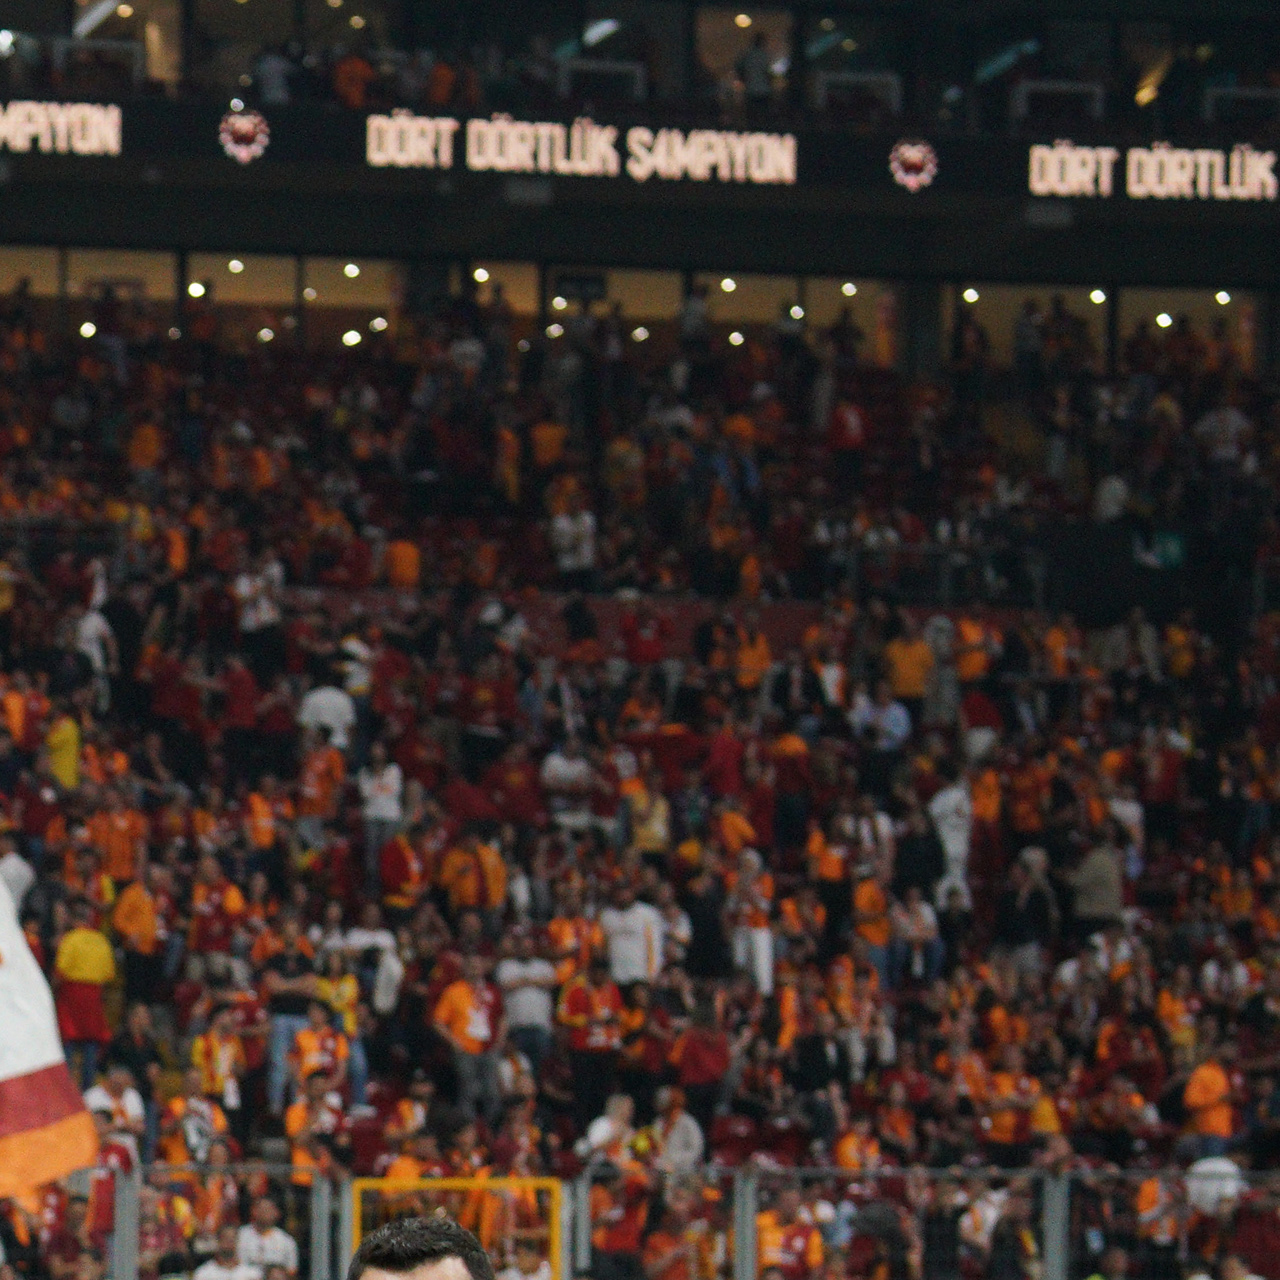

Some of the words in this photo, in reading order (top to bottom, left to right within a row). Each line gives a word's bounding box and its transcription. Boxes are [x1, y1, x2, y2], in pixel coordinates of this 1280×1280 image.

[366, 107, 460, 169] DÖRT
[465, 112, 621, 177] DÖRTLÜK
[1028, 139, 1120, 198] DÖRT
[1125, 141, 1280, 200] DÖRTLÜK
